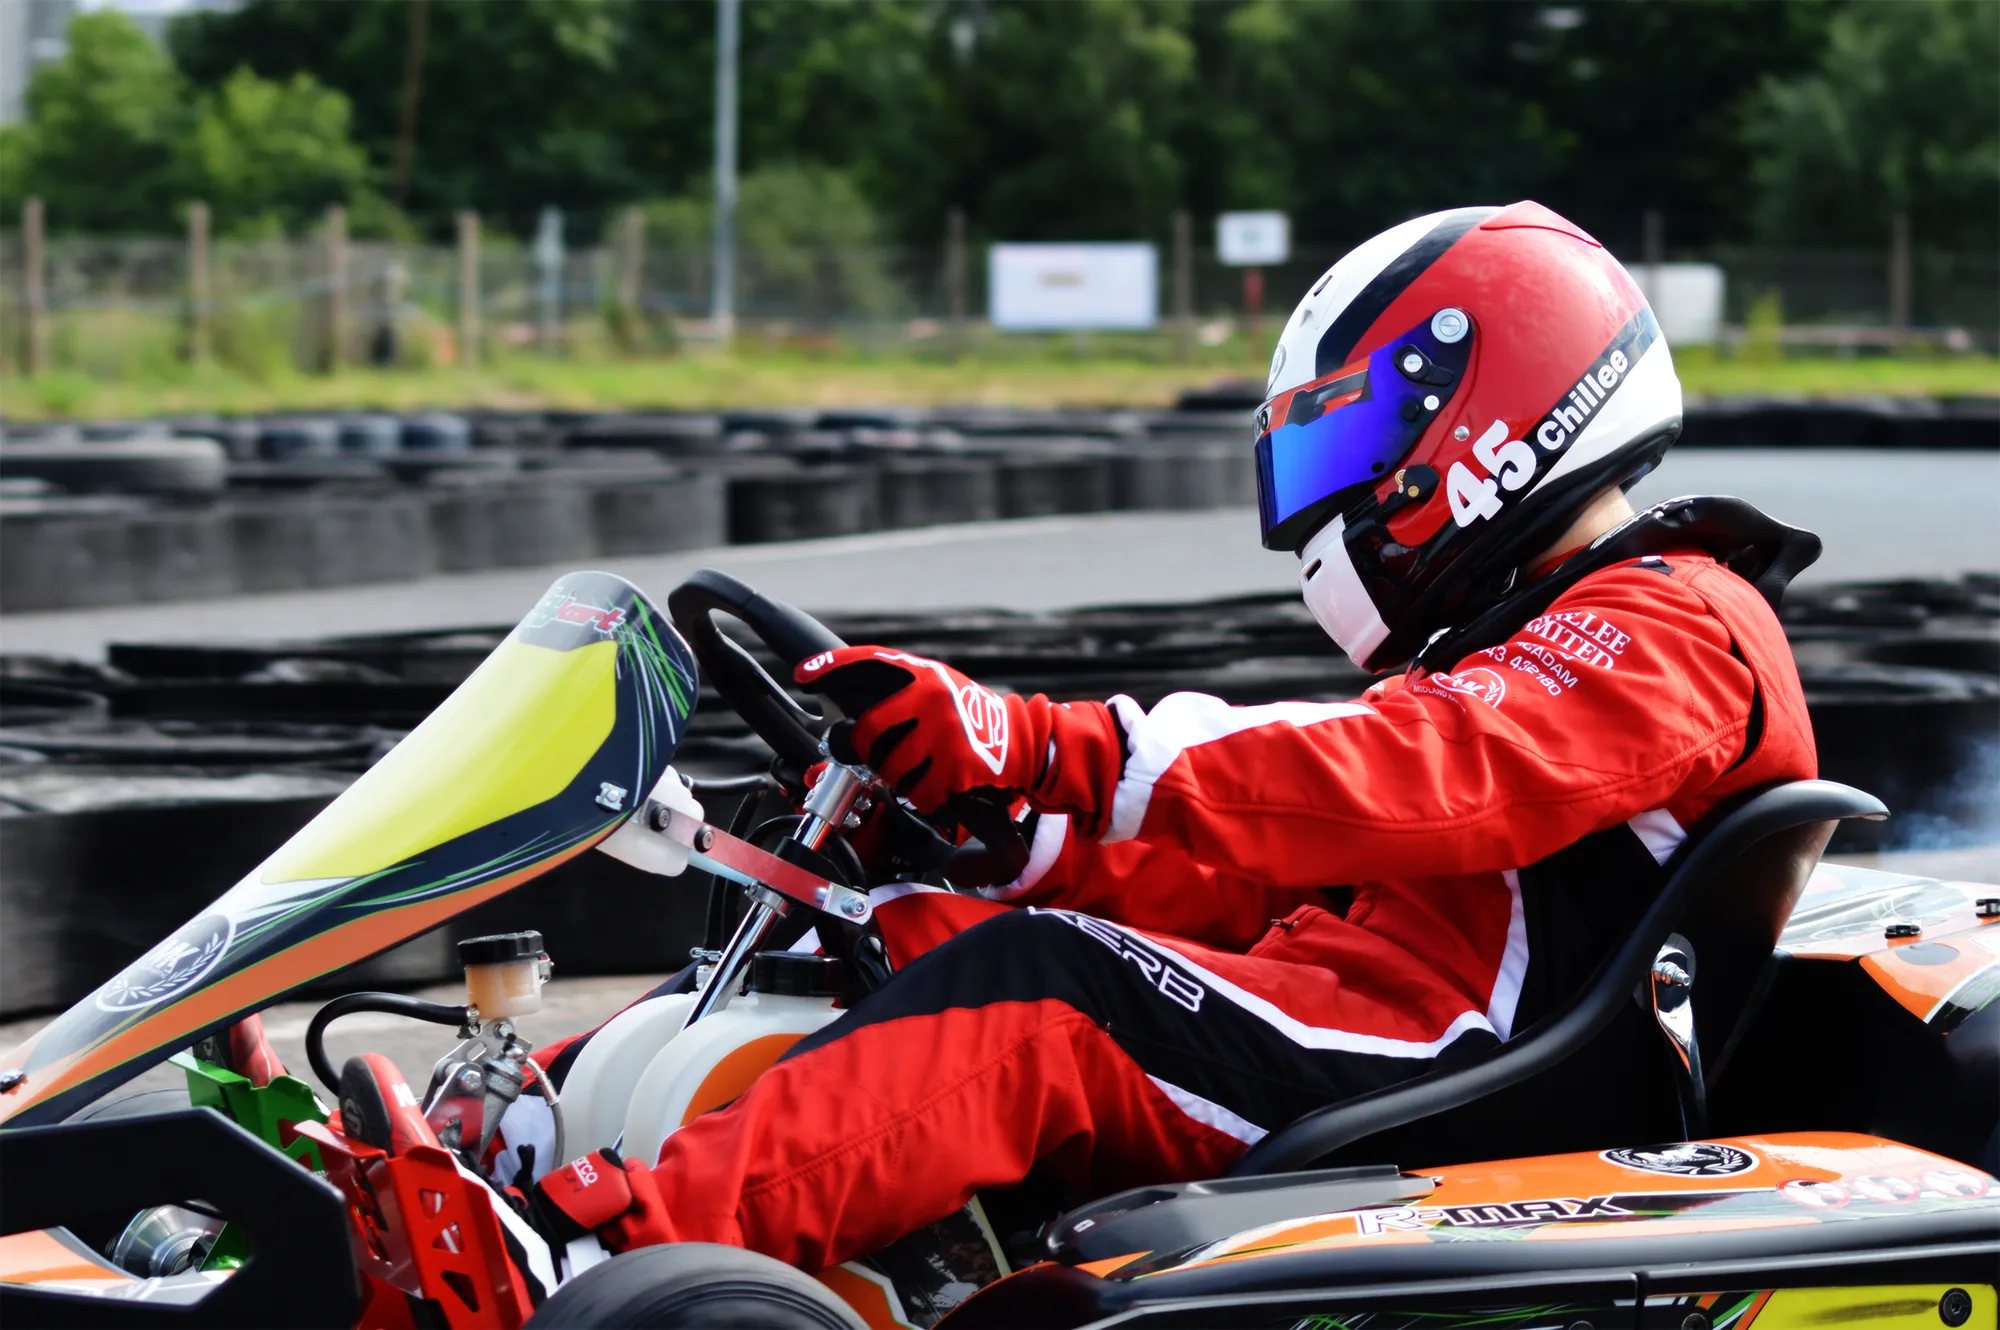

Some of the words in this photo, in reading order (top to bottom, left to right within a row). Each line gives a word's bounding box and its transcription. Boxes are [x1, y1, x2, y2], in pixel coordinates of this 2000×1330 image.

[1536, 349, 1629, 451] chillee
[1446, 418, 1537, 528] 45
[1413, 684, 1449, 697] MIDLAND
